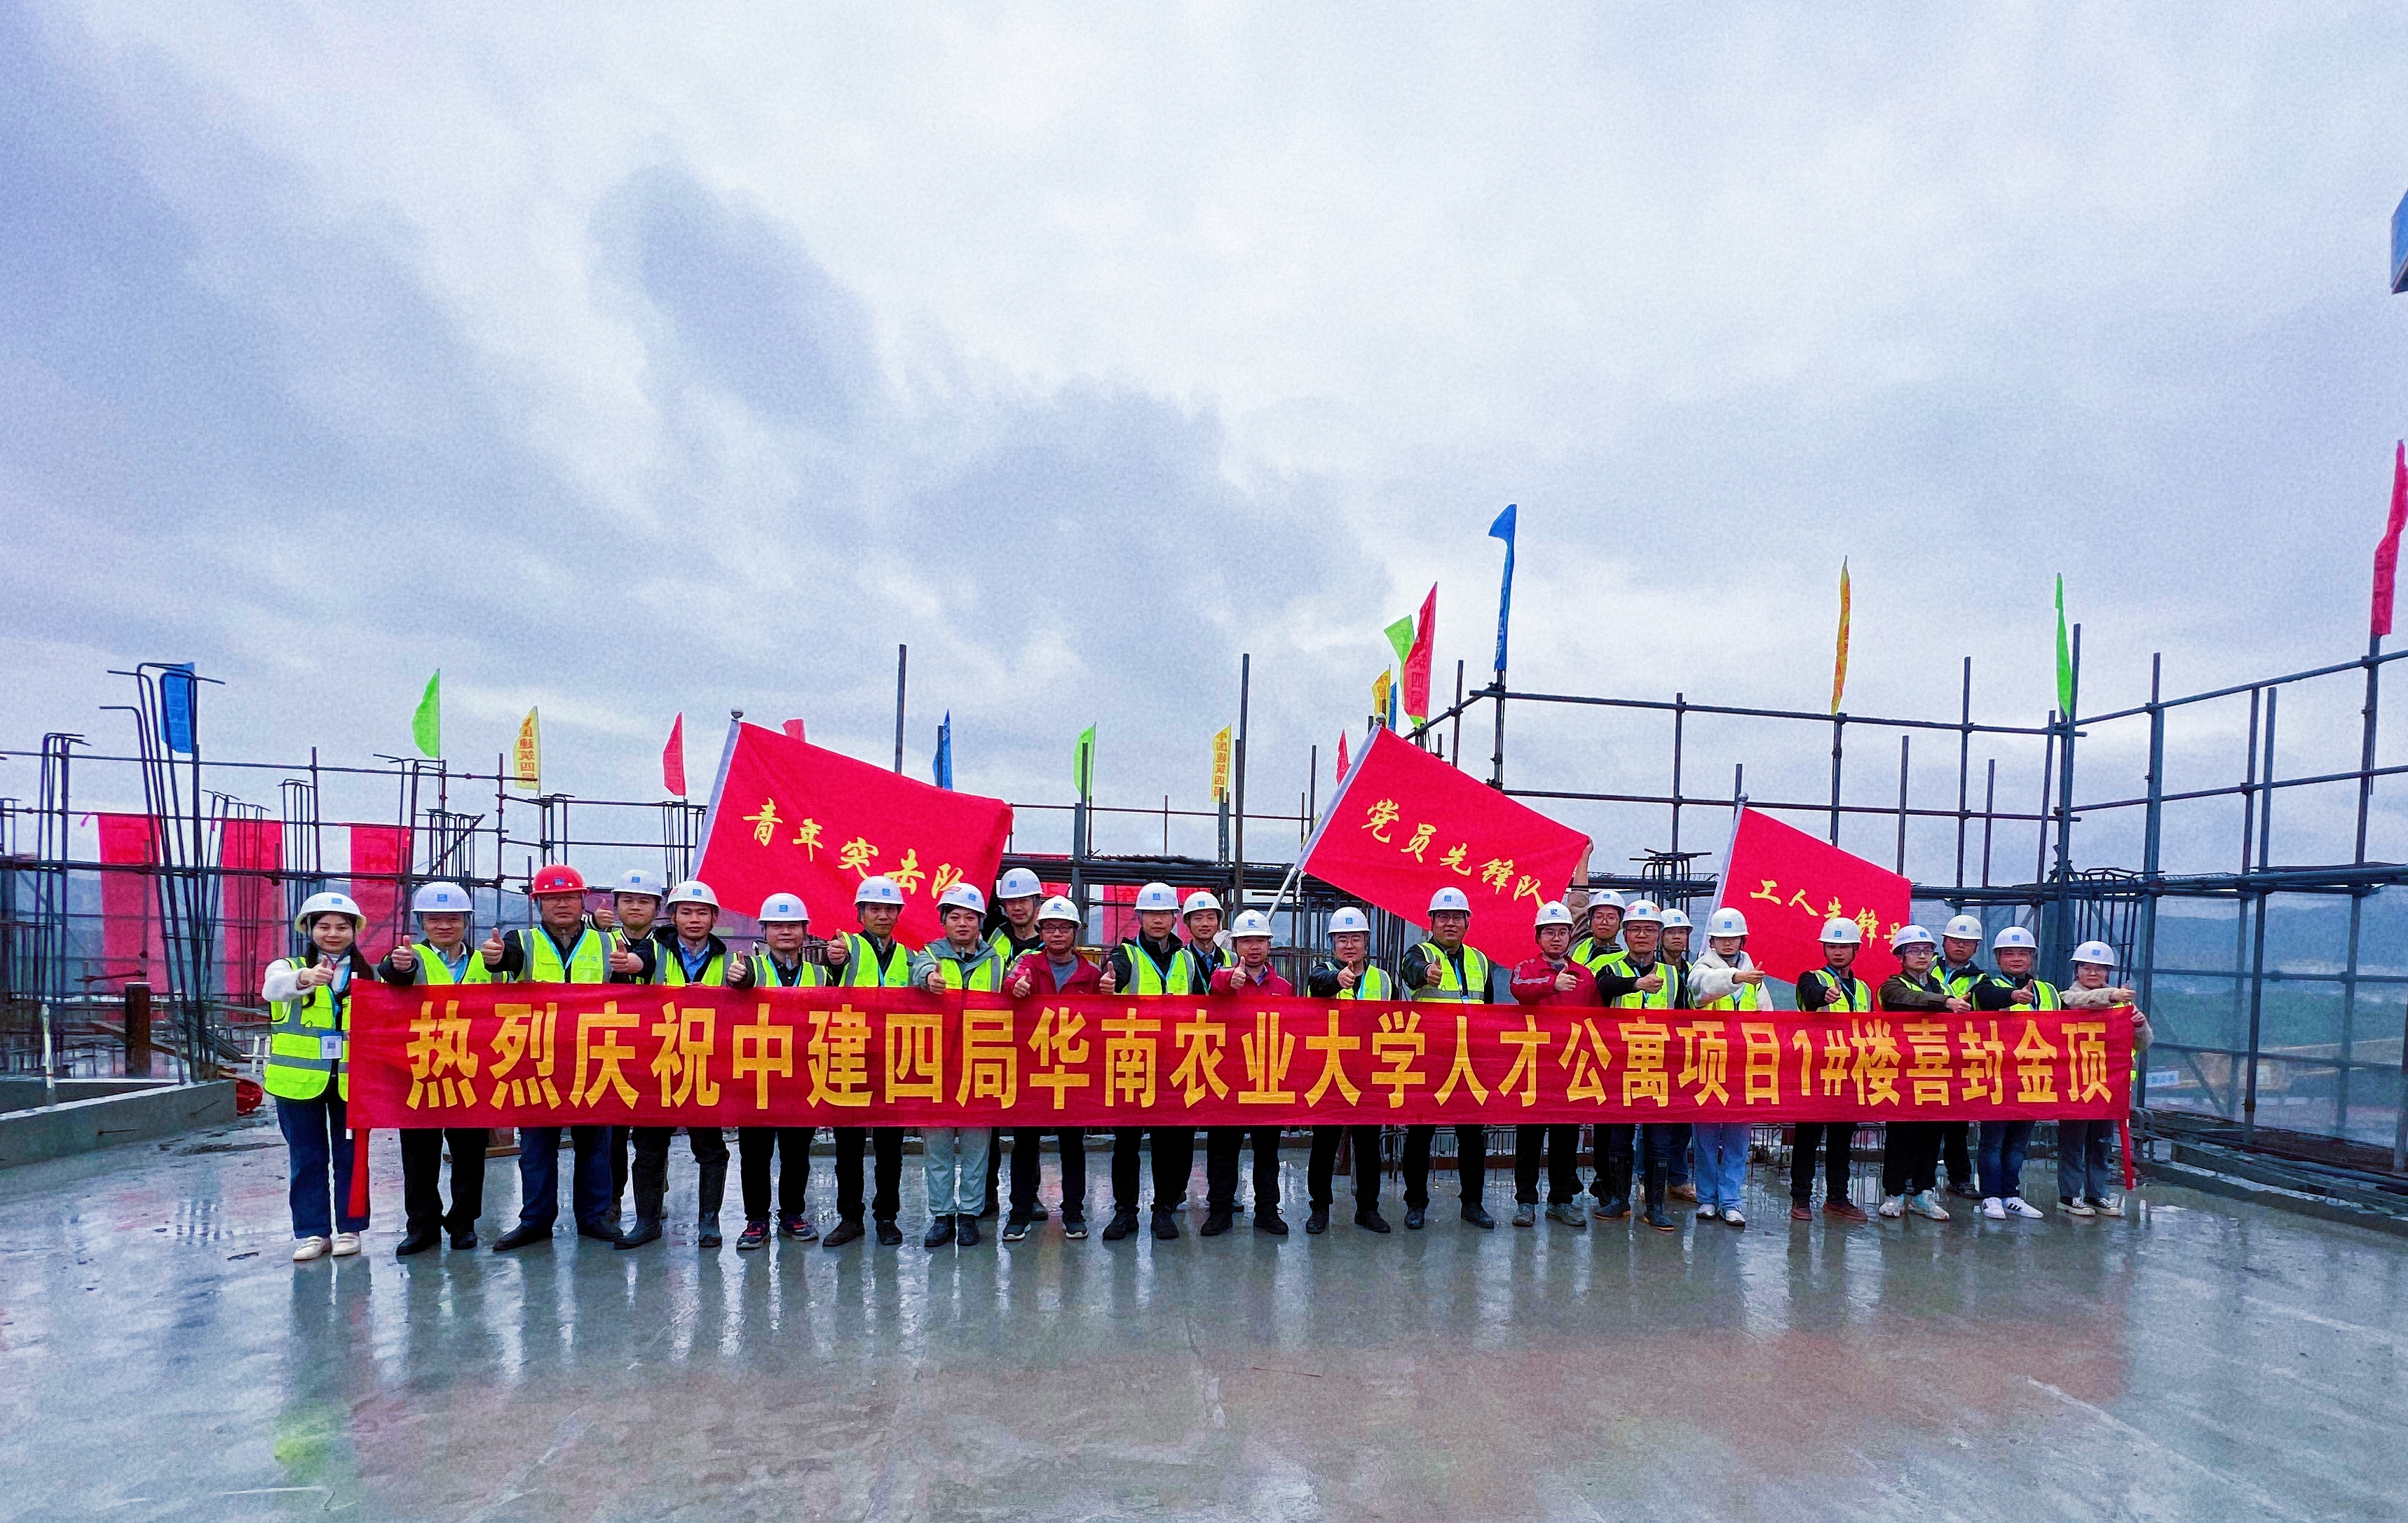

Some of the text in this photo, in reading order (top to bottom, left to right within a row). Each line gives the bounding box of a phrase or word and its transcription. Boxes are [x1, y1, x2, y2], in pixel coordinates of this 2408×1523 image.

[742, 797, 964, 899] 青年突击队
[1361, 798, 1545, 909] 党员先锋队
[406, 1001, 2112, 1110] 热烈庆祝中建四局华南农业大学人才公寓项目1#楼喜封金顶
